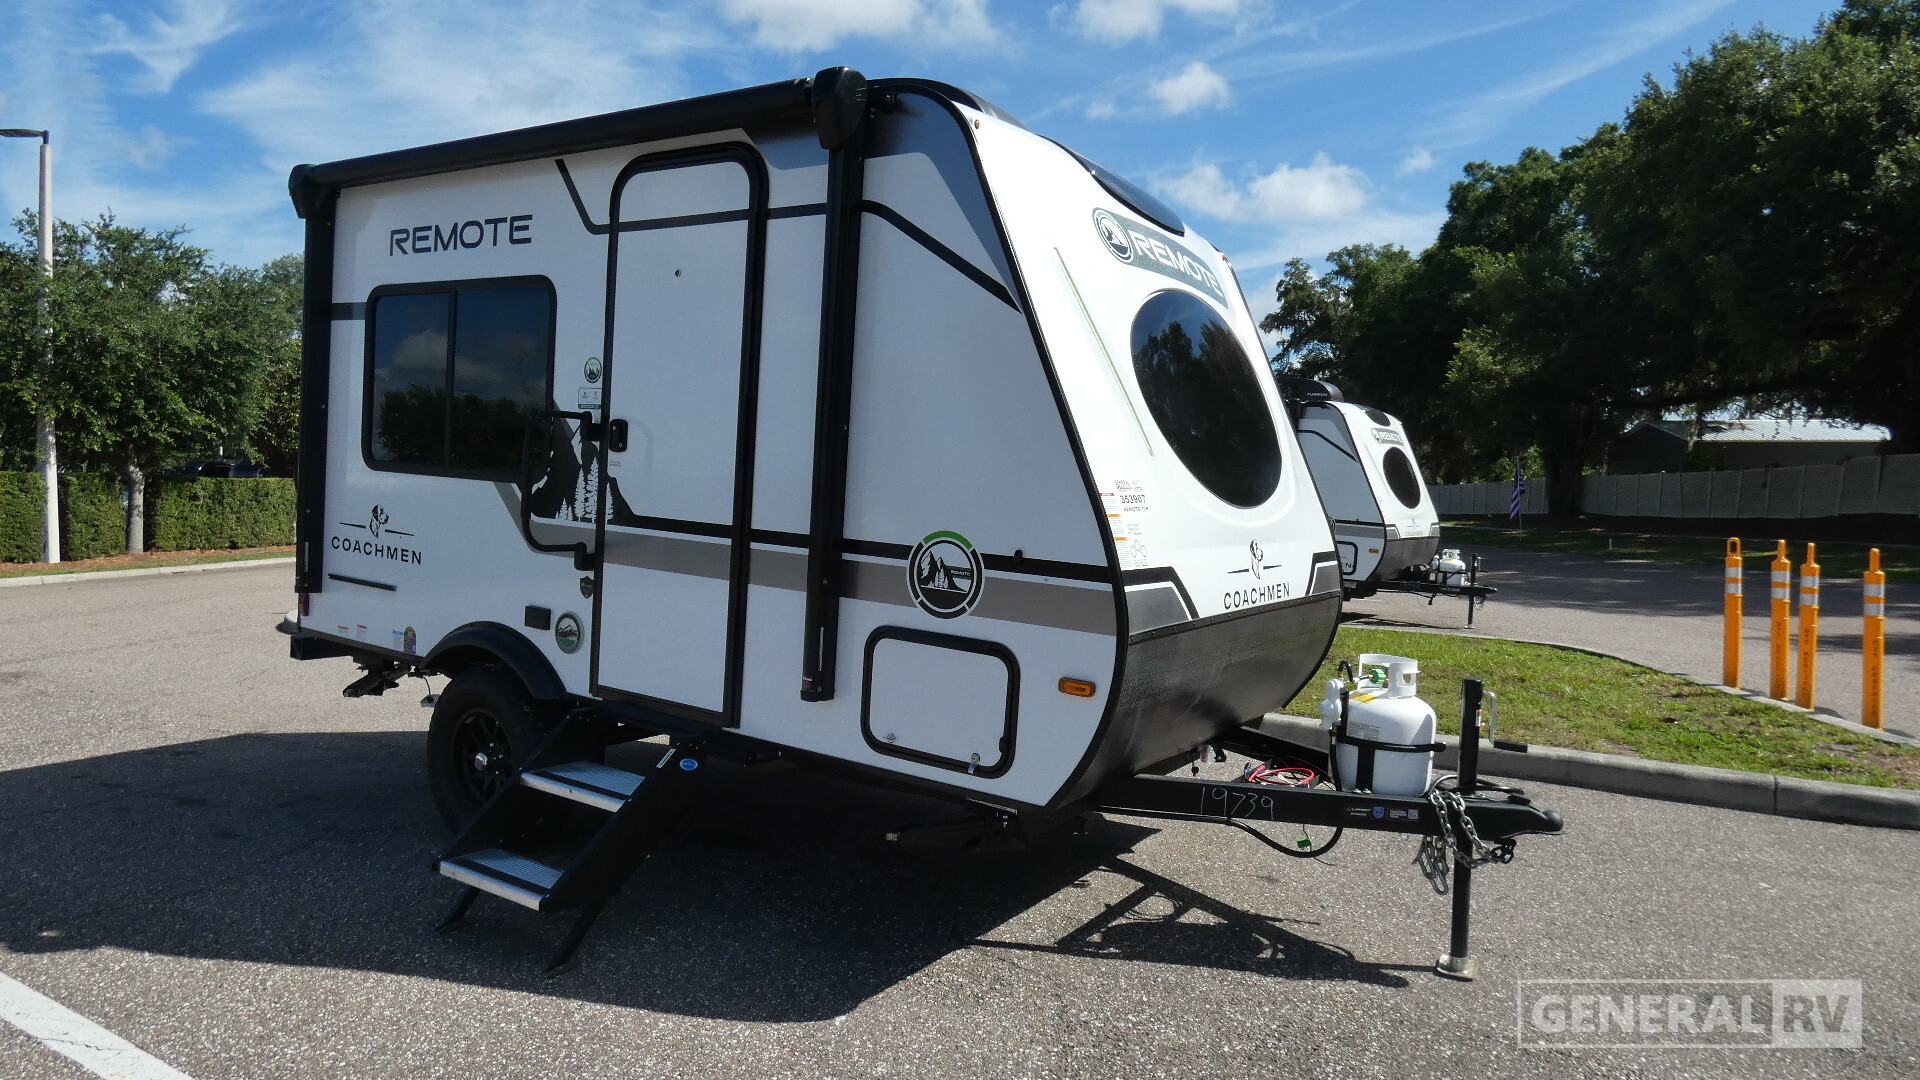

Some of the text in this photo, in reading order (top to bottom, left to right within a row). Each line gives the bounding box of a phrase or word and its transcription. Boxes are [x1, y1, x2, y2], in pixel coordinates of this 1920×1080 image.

[389, 214, 533, 256] REMOTE
[1127, 229, 1225, 297] REMOTE
[1119, 494, 1146, 504] 353907
[331, 536, 422, 565] COACHMEN
[1223, 582, 1290, 610] COACHMEN
[1200, 786, 1274, 822] 19739
